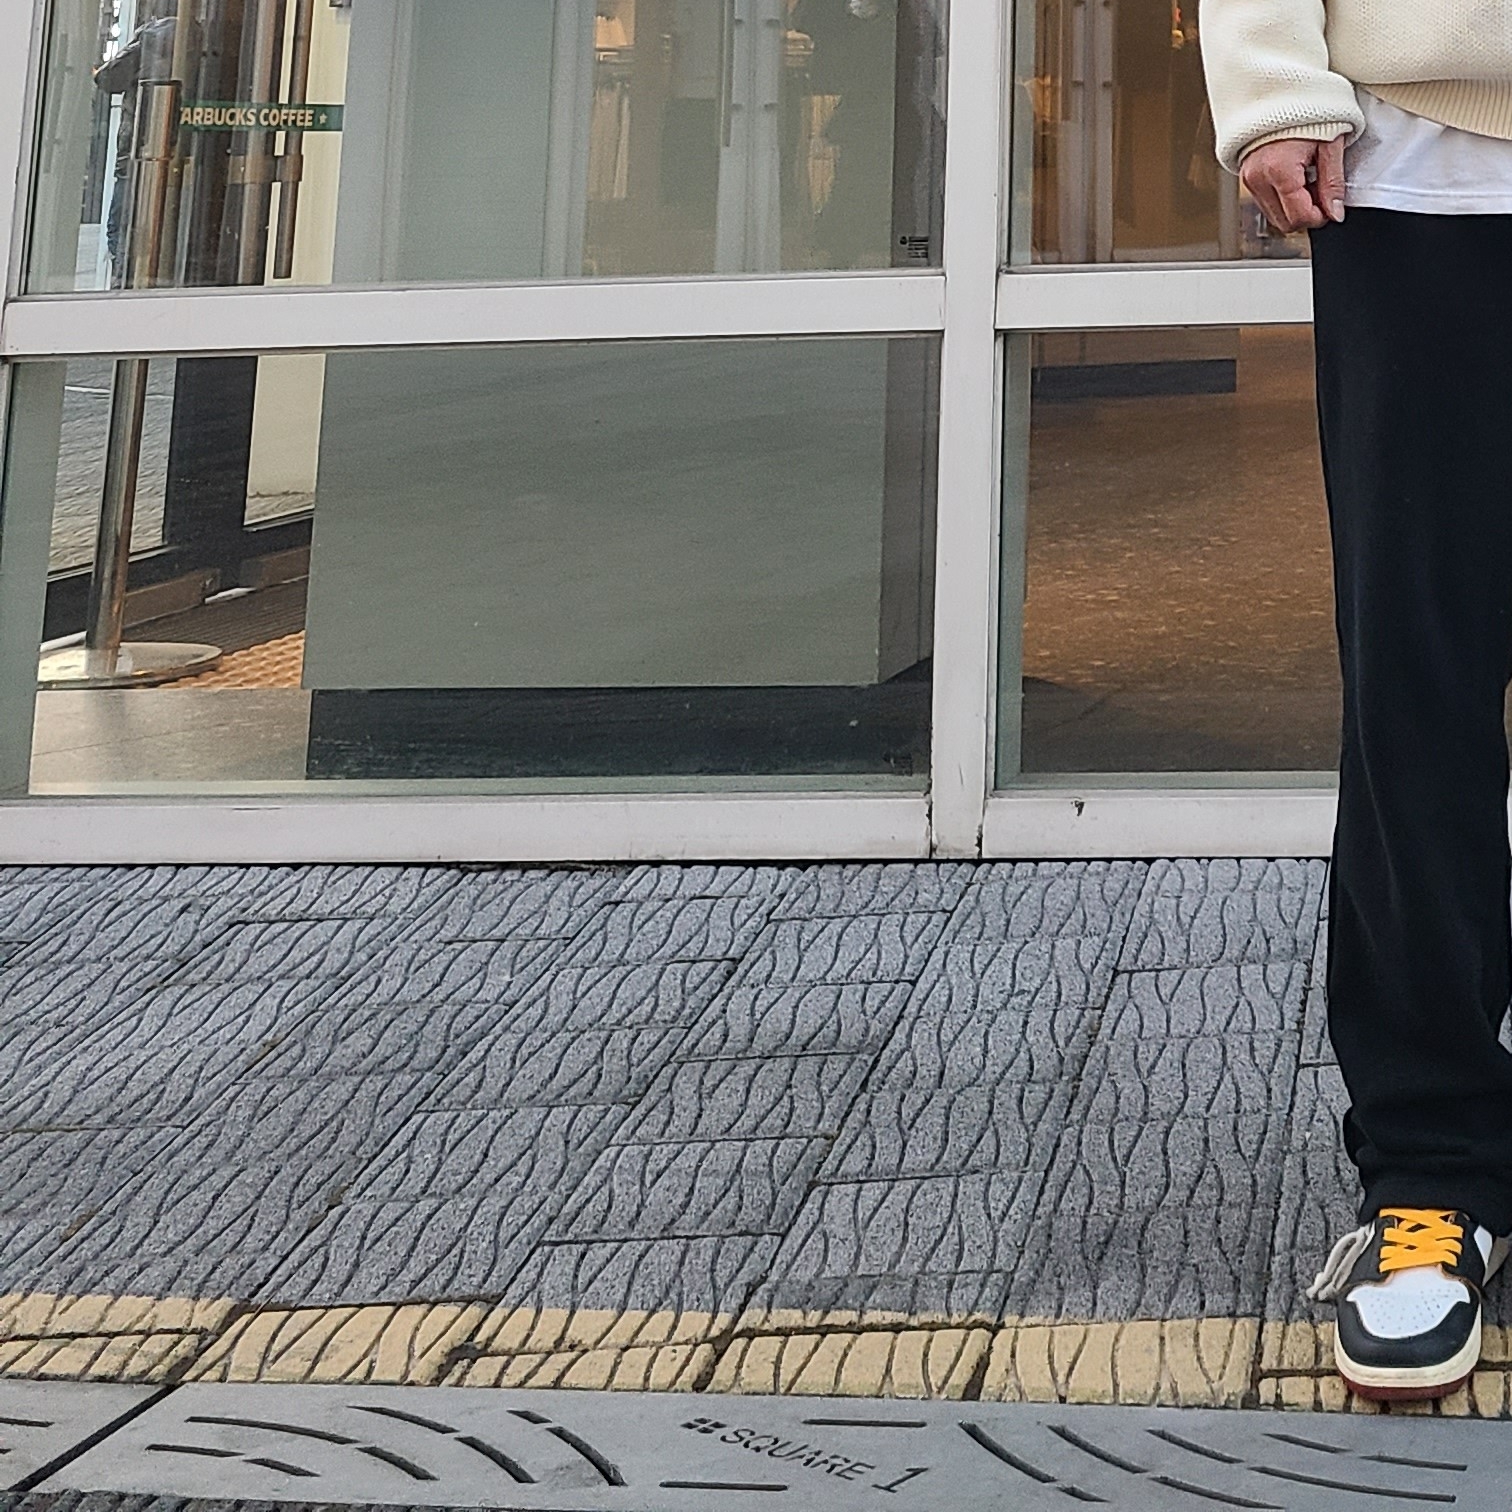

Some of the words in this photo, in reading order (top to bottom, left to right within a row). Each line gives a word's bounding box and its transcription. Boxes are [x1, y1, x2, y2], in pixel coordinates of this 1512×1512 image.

[179, 107, 256, 126] ARBUCKS
[259, 108, 314, 127] COFFEE
[719, 1428, 876, 1480] SQUARE
[871, 1466, 929, 1494] 1
